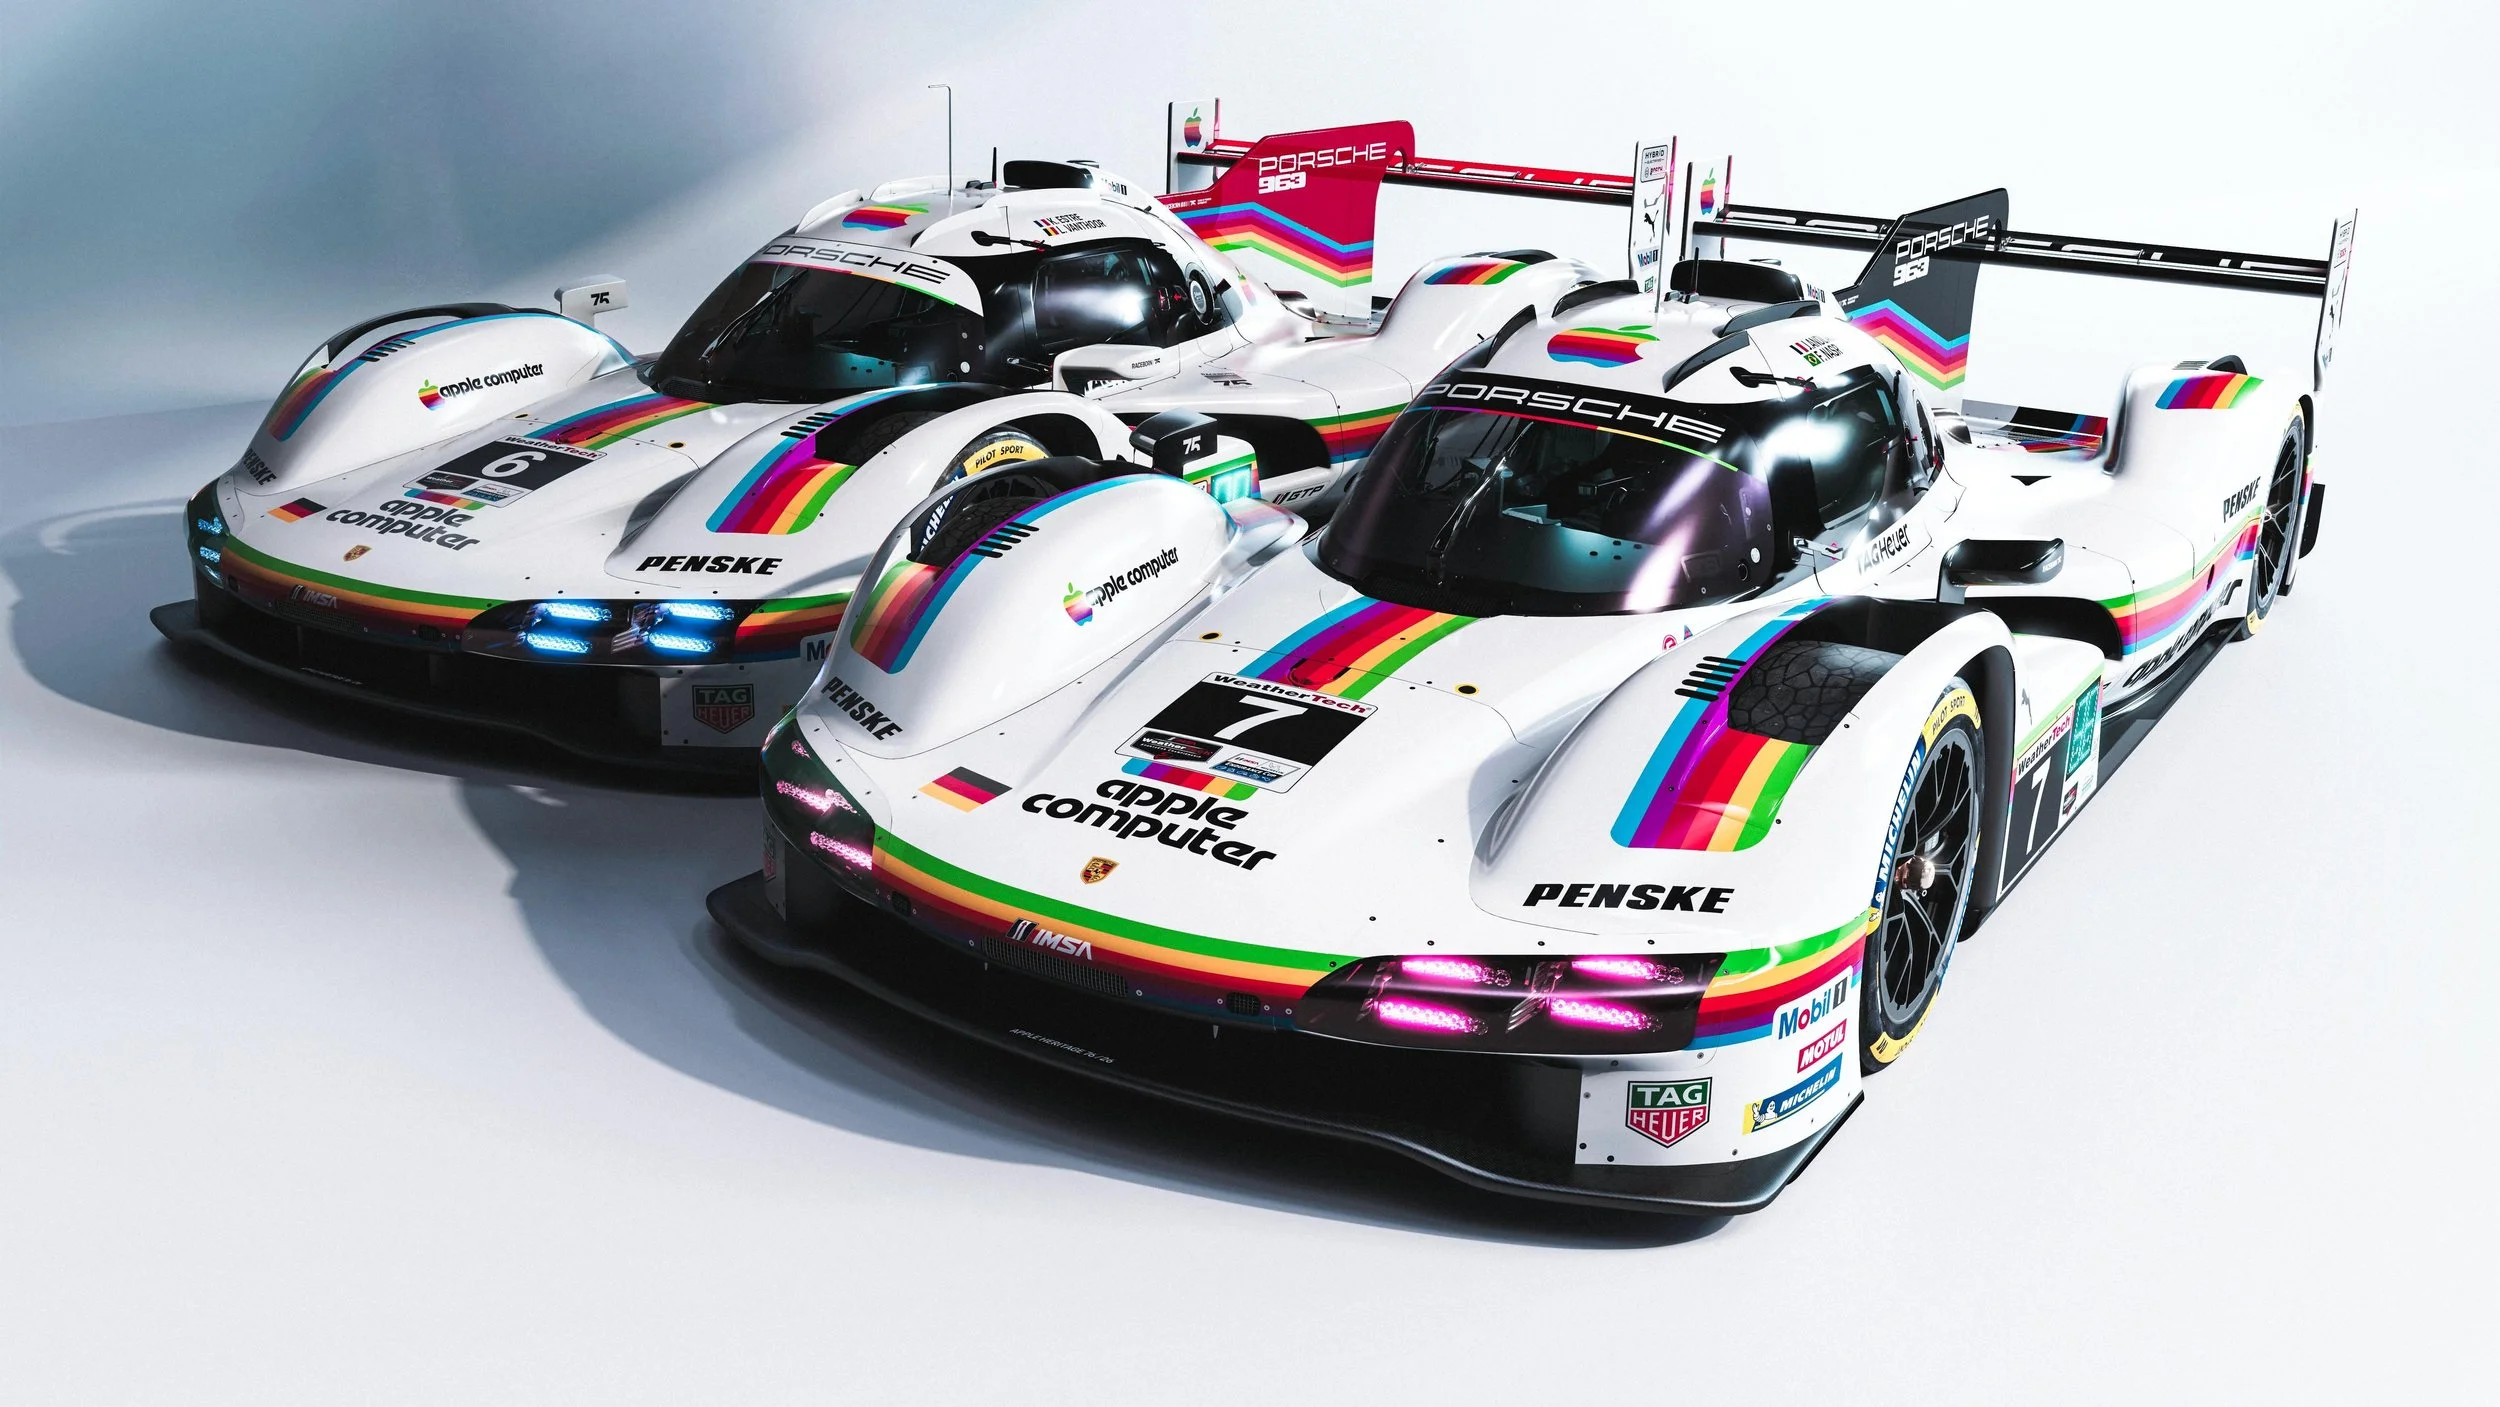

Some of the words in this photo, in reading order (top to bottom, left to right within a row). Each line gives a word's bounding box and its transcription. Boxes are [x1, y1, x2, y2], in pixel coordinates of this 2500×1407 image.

[1259, 142, 1387, 176] PORSCHE
[1645, 148, 1665, 159] HYBRID
[1258, 171, 1307, 195] 963
[1055, 213, 1083, 224] ESTRE
[1063, 219, 1107, 233] VANTHOOR
[1895, 214, 1990, 265] PORSCHE
[761, 244, 951, 285] ORSCHE
[1893, 255, 1930, 287] 963
[590, 291, 610, 306] 75
[439, 377, 484, 398] apple
[483, 363, 544, 388] computer
[1131, 360, 1154, 370] RACEBORN
[504, 436, 599, 460] WeatherTech
[975, 448, 997, 469] PILOT
[1000, 444, 1024, 456] SPORT
[1182, 434, 1202, 455] 75
[481, 451, 548, 478] 6
[1287, 484, 1326, 502] GTP
[2223, 475, 2262, 524] PENSKE
[326, 509, 481, 551] computer
[379, 500, 475, 528] apple
[636, 555, 783, 576] PENSKE
[1127, 546, 1179, 586] computer
[698, 688, 748, 705] TAG
[820, 676, 903, 741] PENSKE
[1213, 674, 1370, 714] WeatherTech
[696, 705, 750, 729] HEUER
[1213, 694, 1309, 741] 7
[1932, 705, 1948, 736] PILOT
[1950, 695, 1966, 713] SPORT
[2018, 714, 2071, 776] WeatherTech
[1096, 779, 1250, 831] apple
[1878, 749, 1921, 883] MICHELIN
[2026, 756, 2052, 855] 7
[1021, 793, 1278, 871] computer
[1522, 883, 1735, 914] PENSKE
[1032, 928, 1093, 961] IMSA
[1778, 989, 1832, 1040] Mobil
[1833, 977, 1848, 1010] 1
[1009, 1028, 1041, 1041] APPLE
[1039, 1036, 1085, 1054] HERITAGE
[1800, 1027, 1845, 1069] MOTUL
[1636, 1084, 1704, 1107] TAG
[1780, 1066, 1837, 1113] MICHELIN
[1632, 1108, 1705, 1141] HEUER
